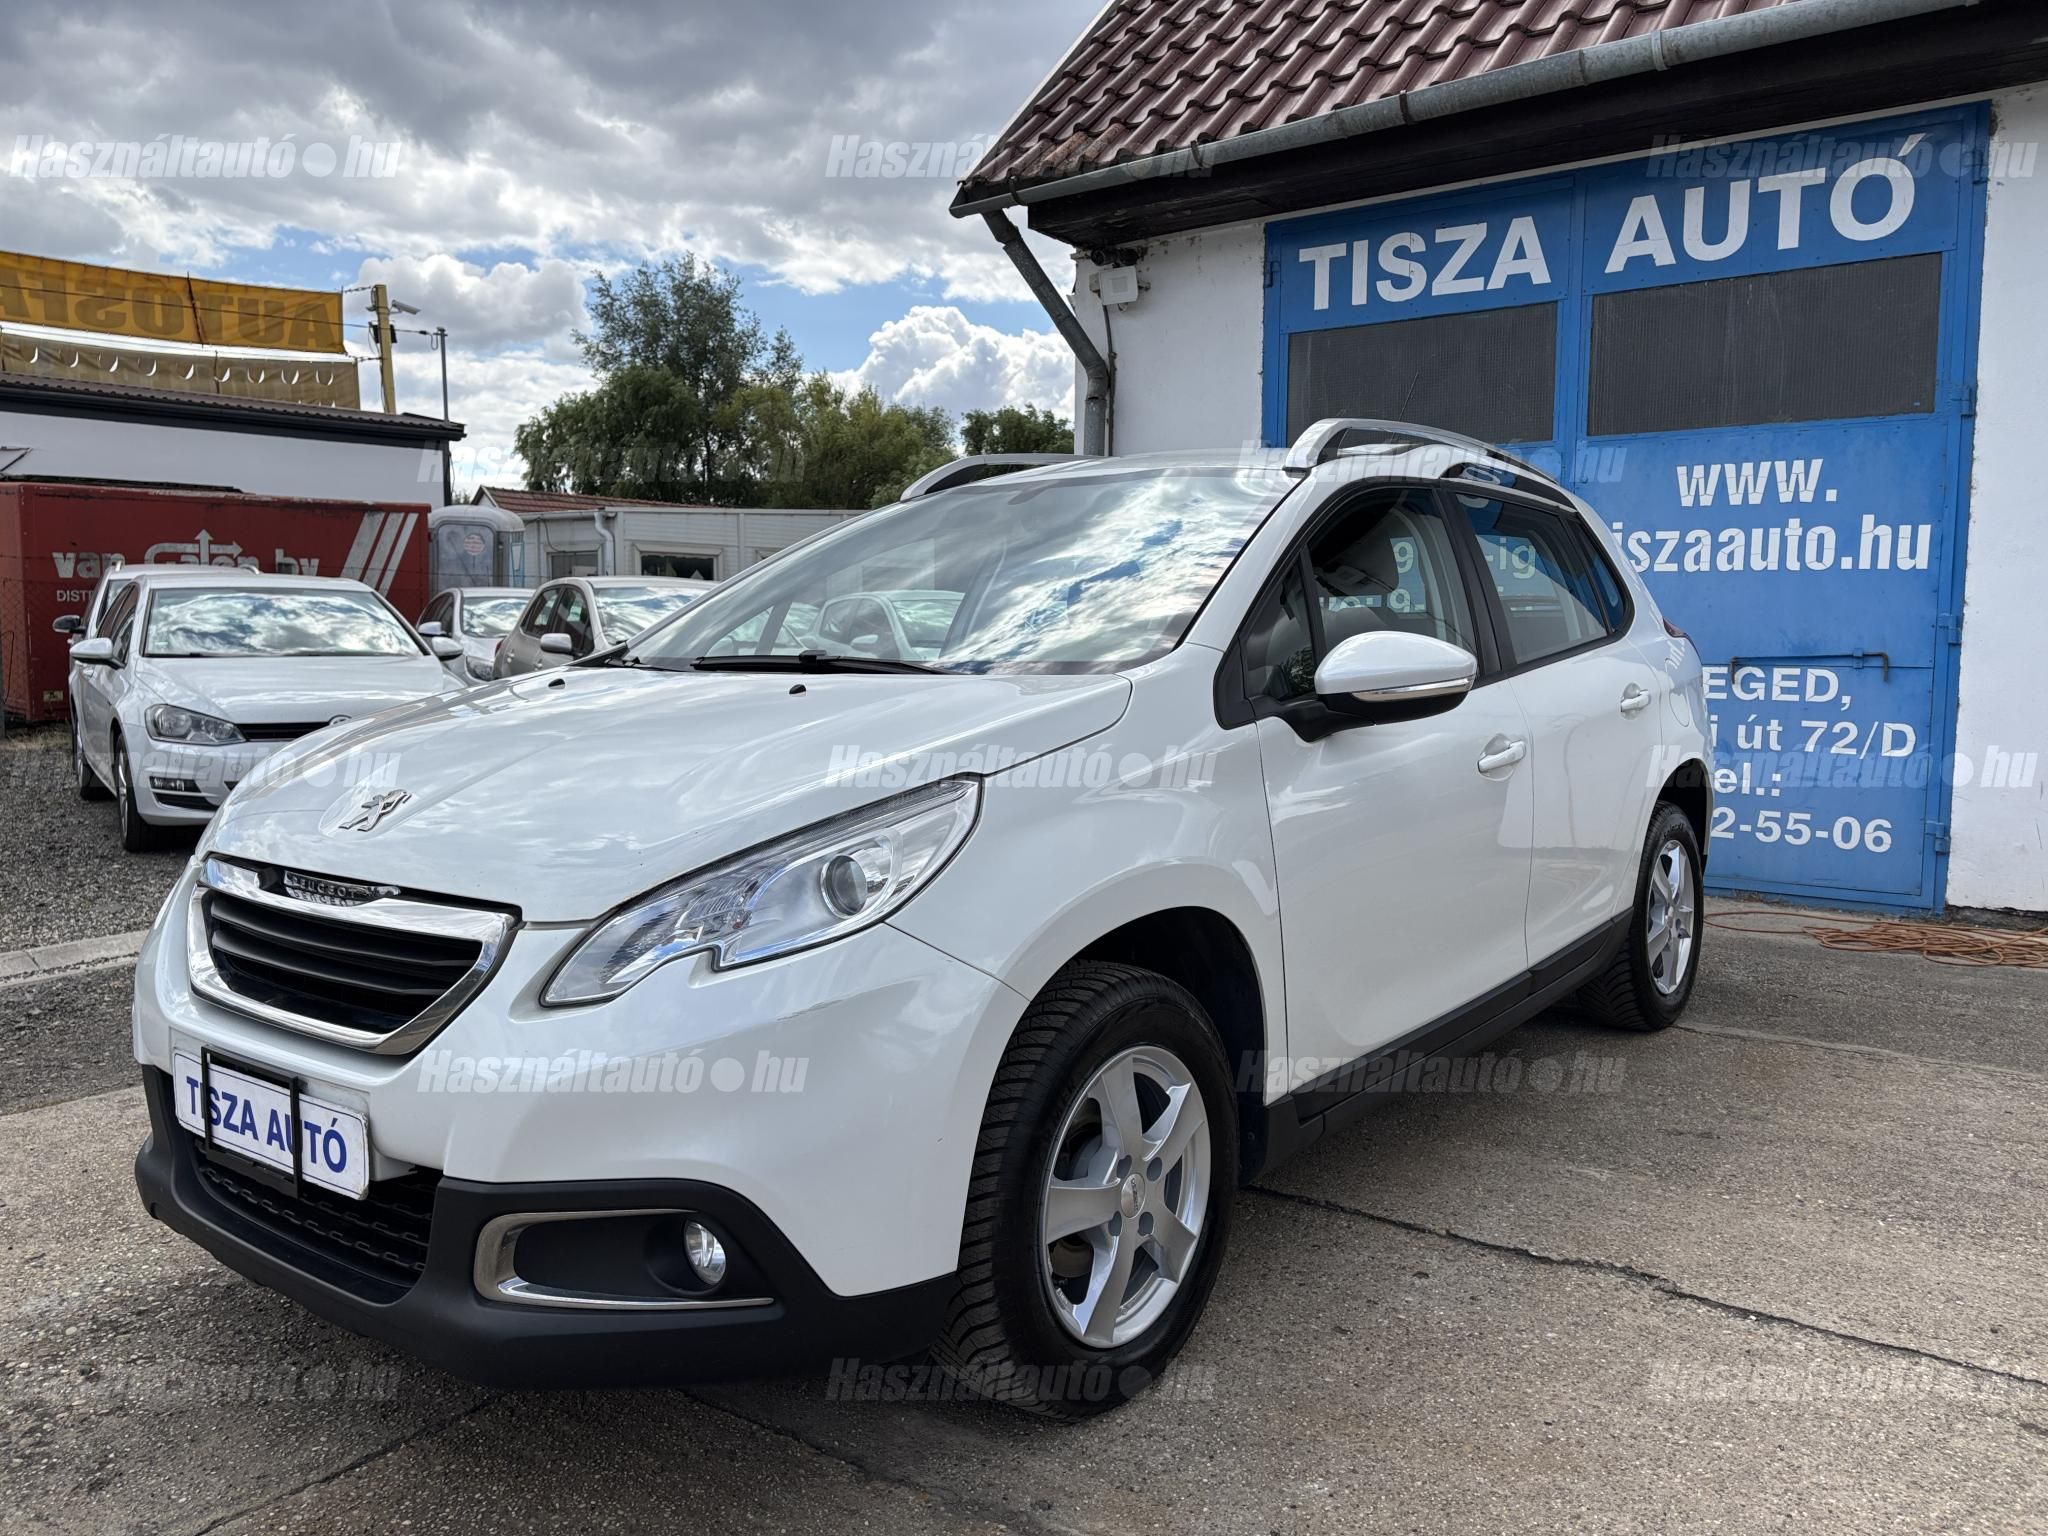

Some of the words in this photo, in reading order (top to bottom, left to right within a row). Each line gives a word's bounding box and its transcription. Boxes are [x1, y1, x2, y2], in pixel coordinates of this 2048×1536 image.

[1299, 216, 1552, 311] TISZA
[1604, 133, 1927, 274] AUTÓ
[1676, 458, 1837, 507] www.
[1611, 514, 1932, 573] iszaauto.hu
[56, 590, 95, 602] DIST
[1702, 666, 1852, 712] EGED,
[1737, 714, 1783, 751] út
[1801, 720, 1917, 760] 72/D
[1713, 762, 1782, 797] el.:
[1711, 806, 1893, 854] 2-55-06
